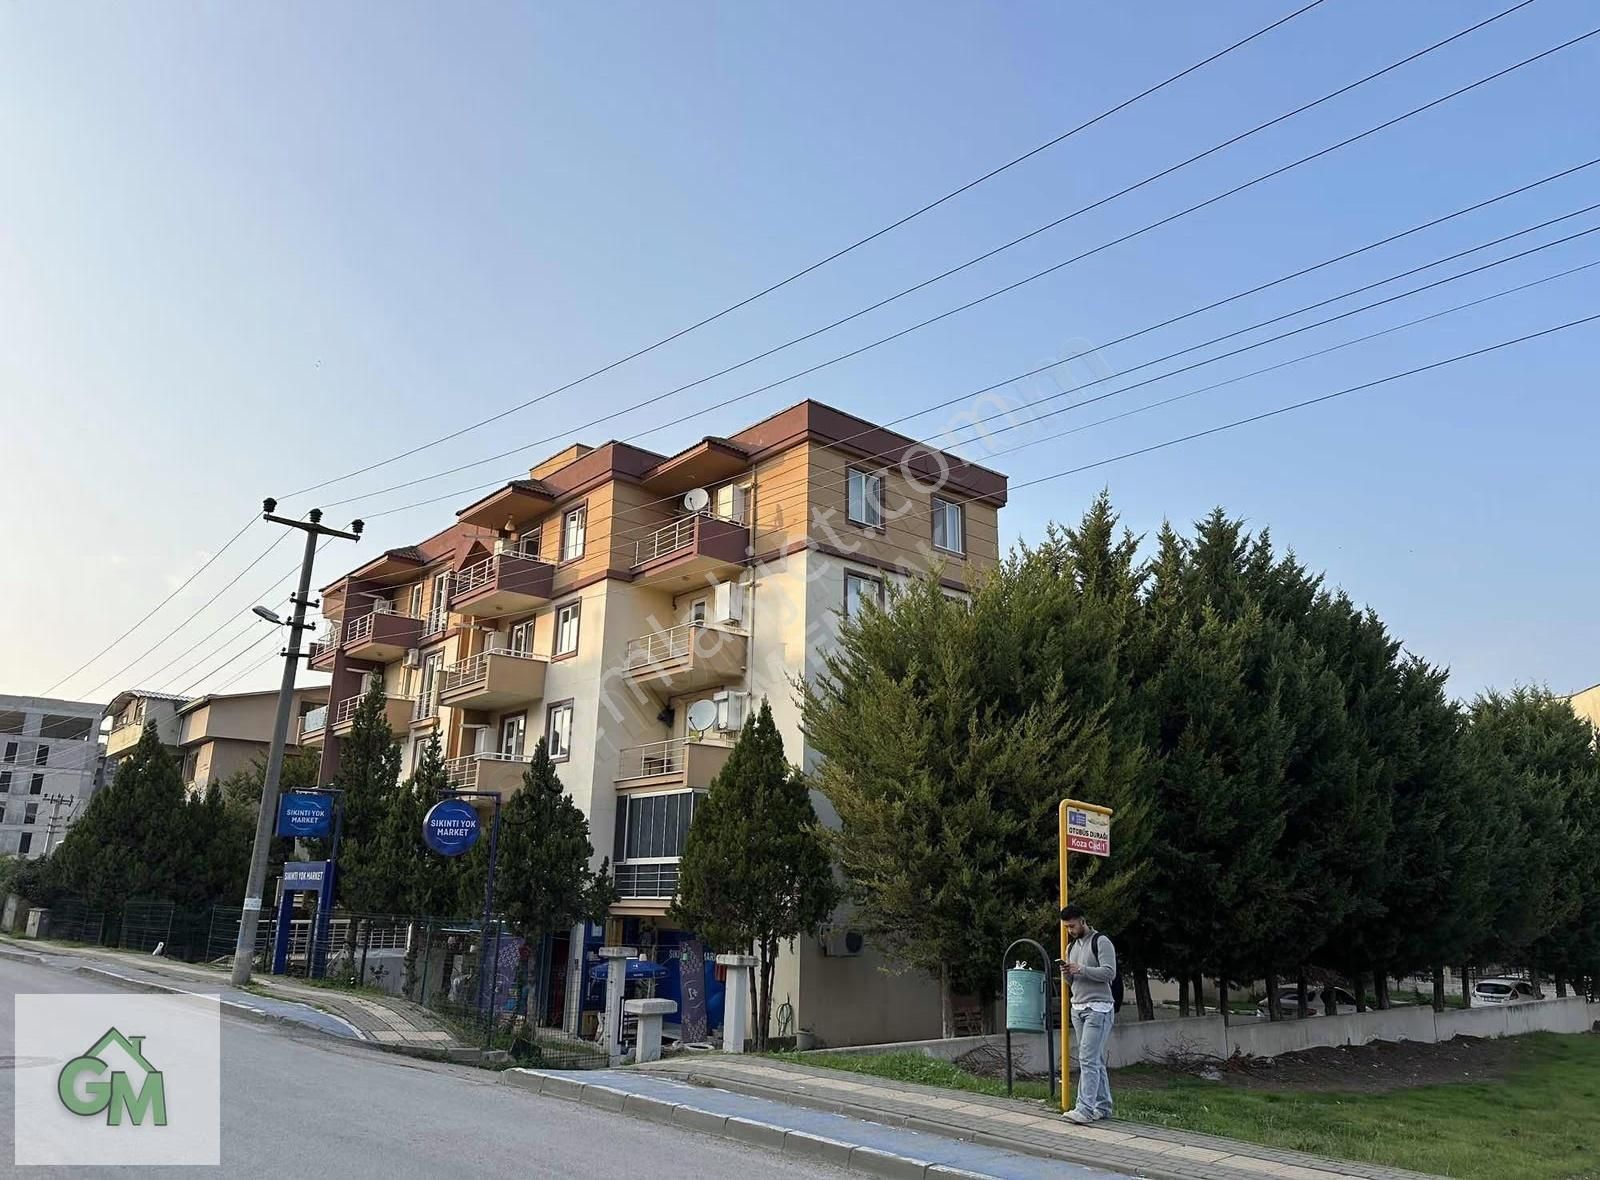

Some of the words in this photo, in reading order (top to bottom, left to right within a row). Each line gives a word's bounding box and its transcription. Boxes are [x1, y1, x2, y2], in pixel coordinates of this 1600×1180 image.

[286, 809, 311, 817] SIKINTI
[430, 819, 460, 828] SIKINTI
[461, 820, 476, 828] YOK
[437, 828, 469, 836] MARKET
[1071, 838, 1087, 848] Koza
